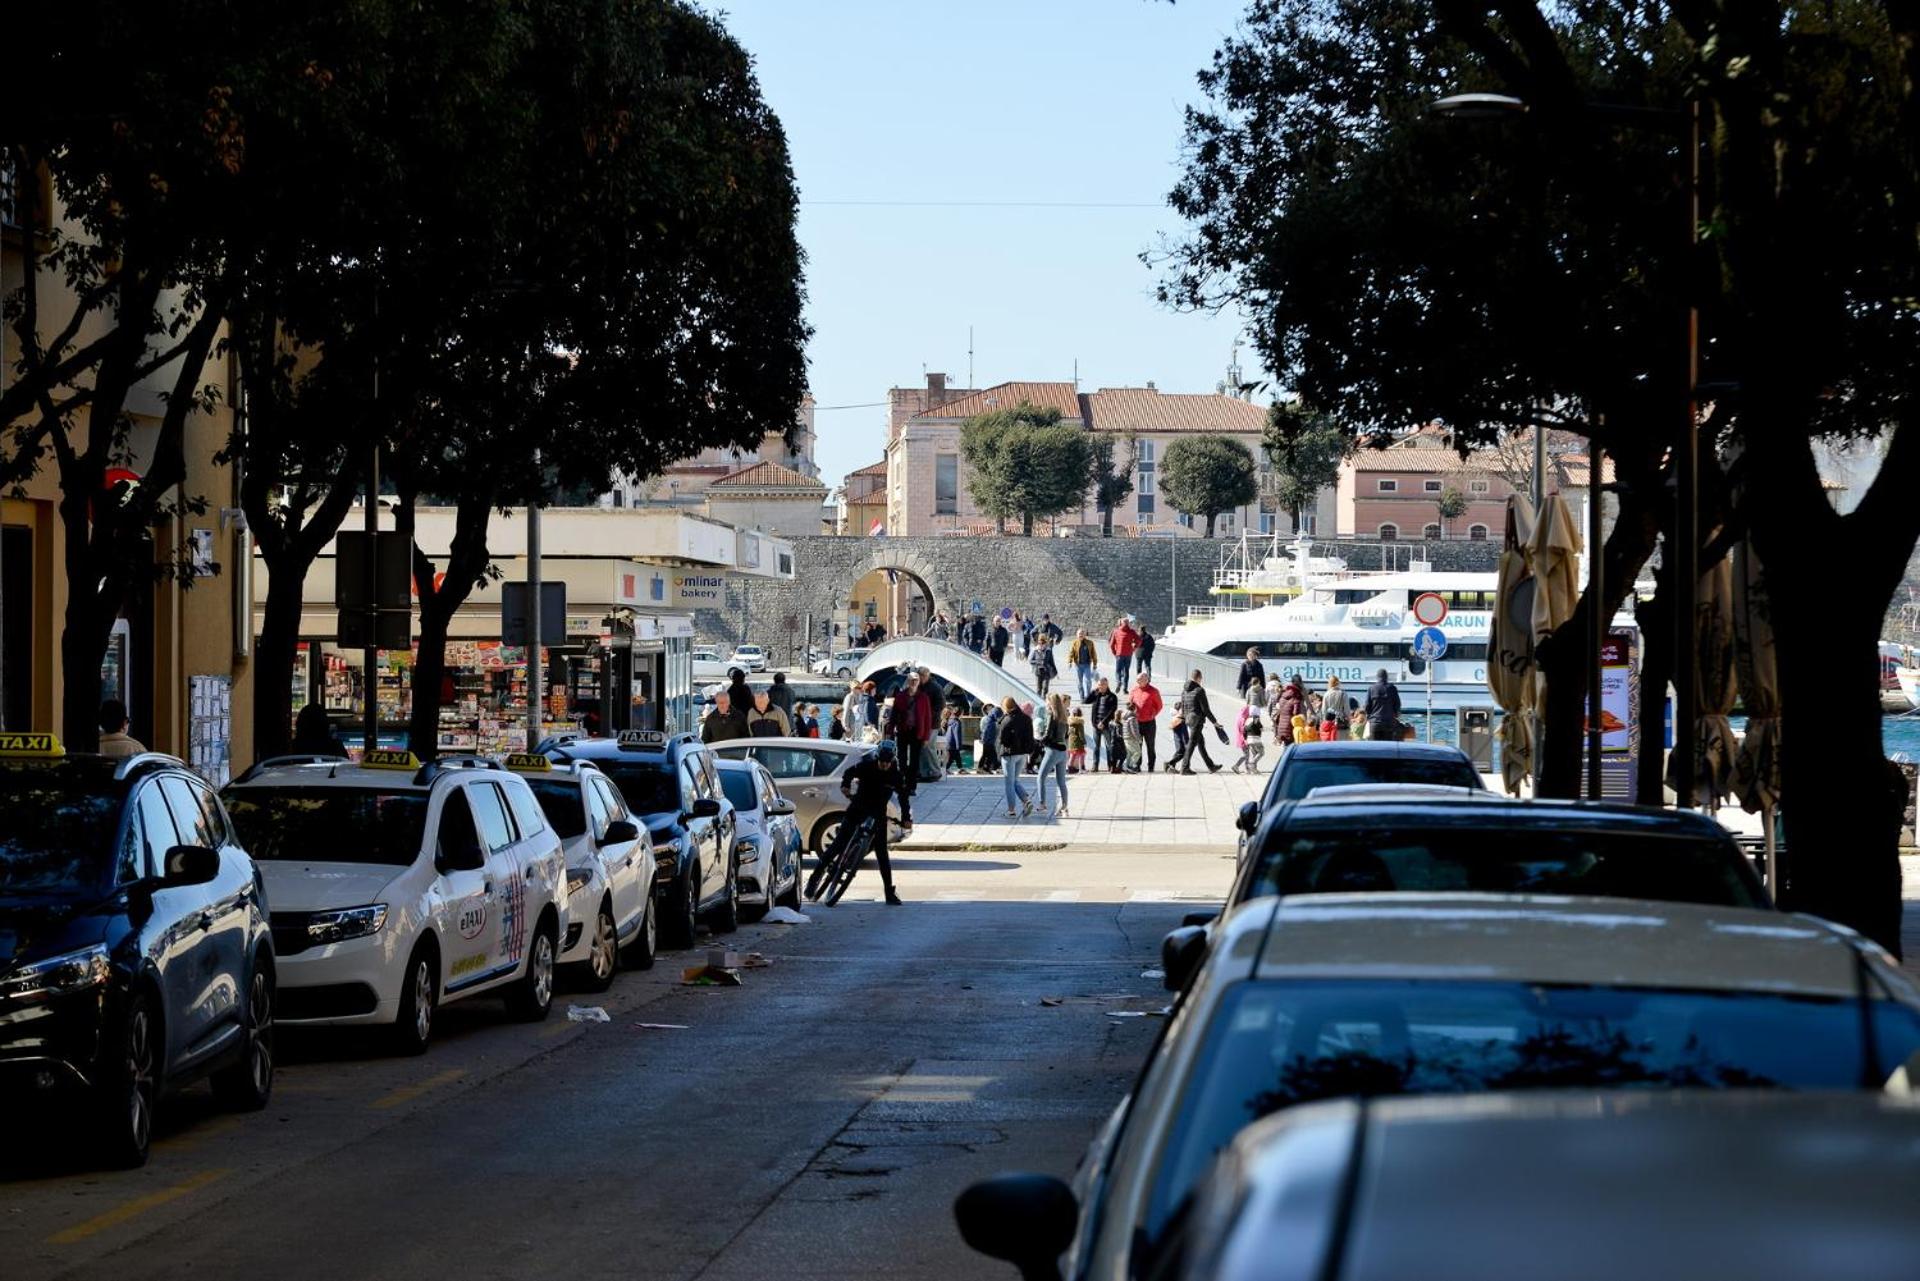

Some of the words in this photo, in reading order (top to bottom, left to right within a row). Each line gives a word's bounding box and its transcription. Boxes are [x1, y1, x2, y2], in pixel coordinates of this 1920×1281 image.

[684, 575, 723, 587] mlinar
[681, 589, 717, 598] bakery
[0, 737, 48, 749] TAXI
[370, 752, 408, 764] TAXI
[512, 756, 544, 766] TAXI
[460, 908, 482, 930] eTAXI
